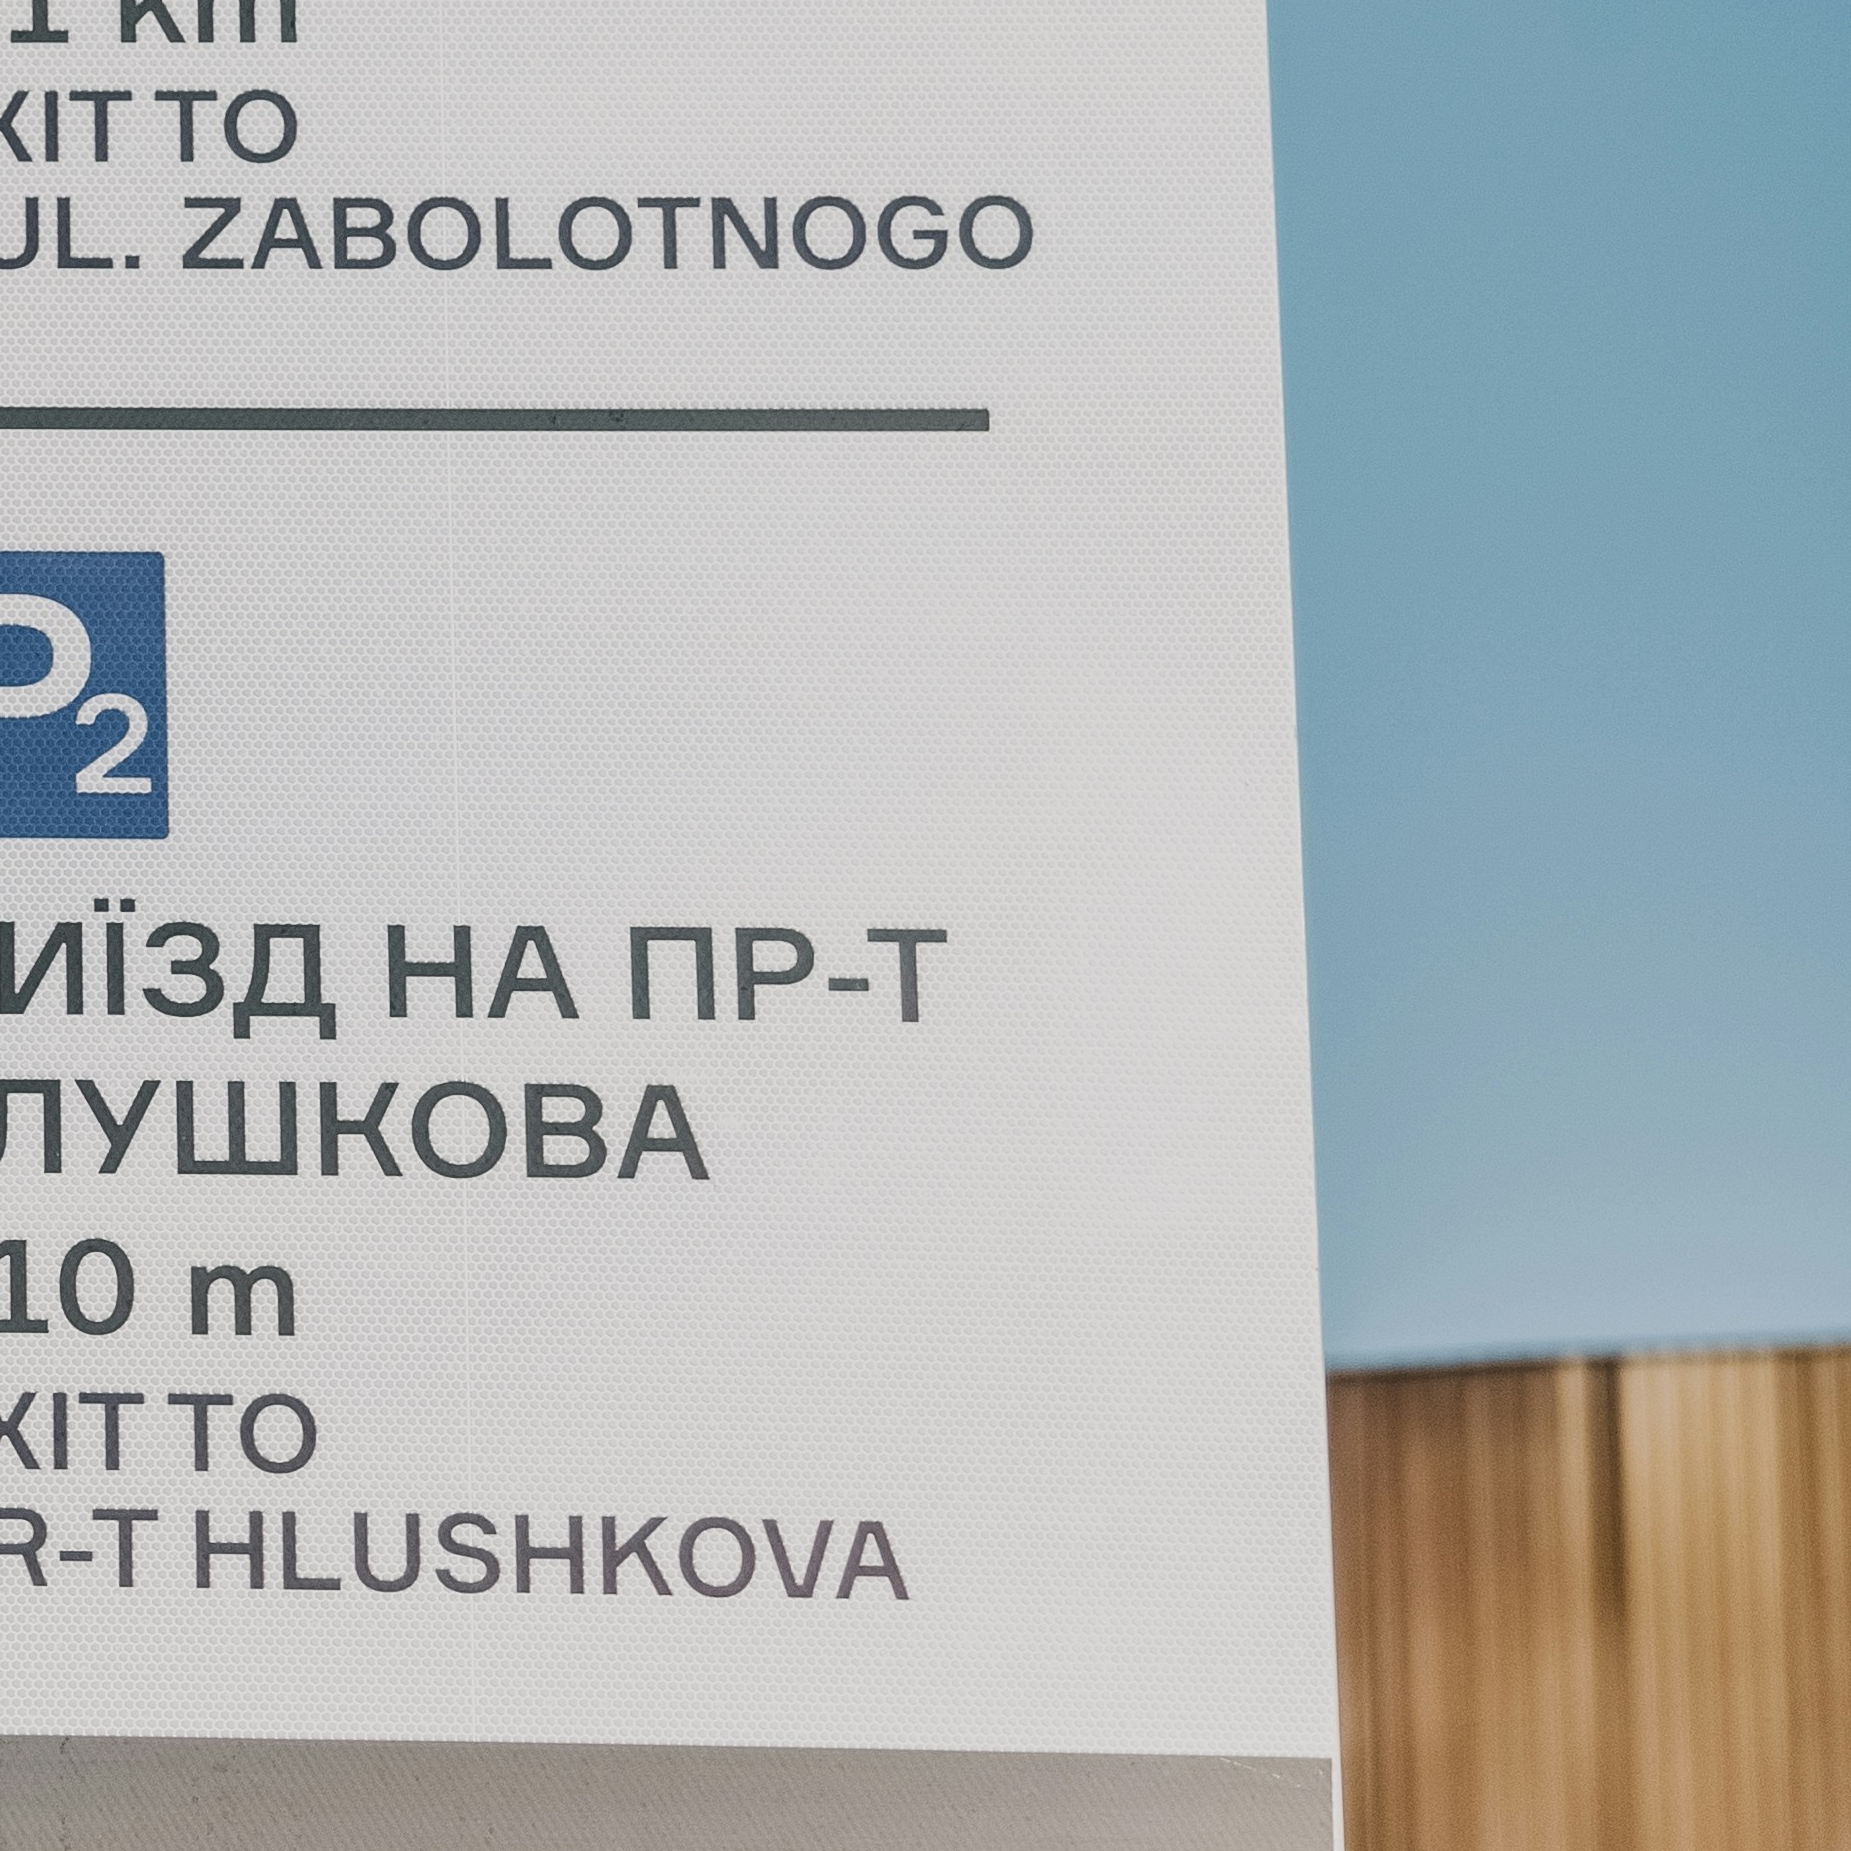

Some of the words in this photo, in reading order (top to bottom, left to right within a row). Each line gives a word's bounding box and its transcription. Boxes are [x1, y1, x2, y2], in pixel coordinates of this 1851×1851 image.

[155, 89, 297, 163] TO
[182, 195, 1033, 270] ZABOLOTNOGO
[387, 924, 579, 1019] НА
[630, 927, 947, 1022] ПР-Т
[191, 1265, 295, 1336] m
[168, 1393, 317, 1474] TO
[195, 1510, 909, 1600] HLUSHKOVA
